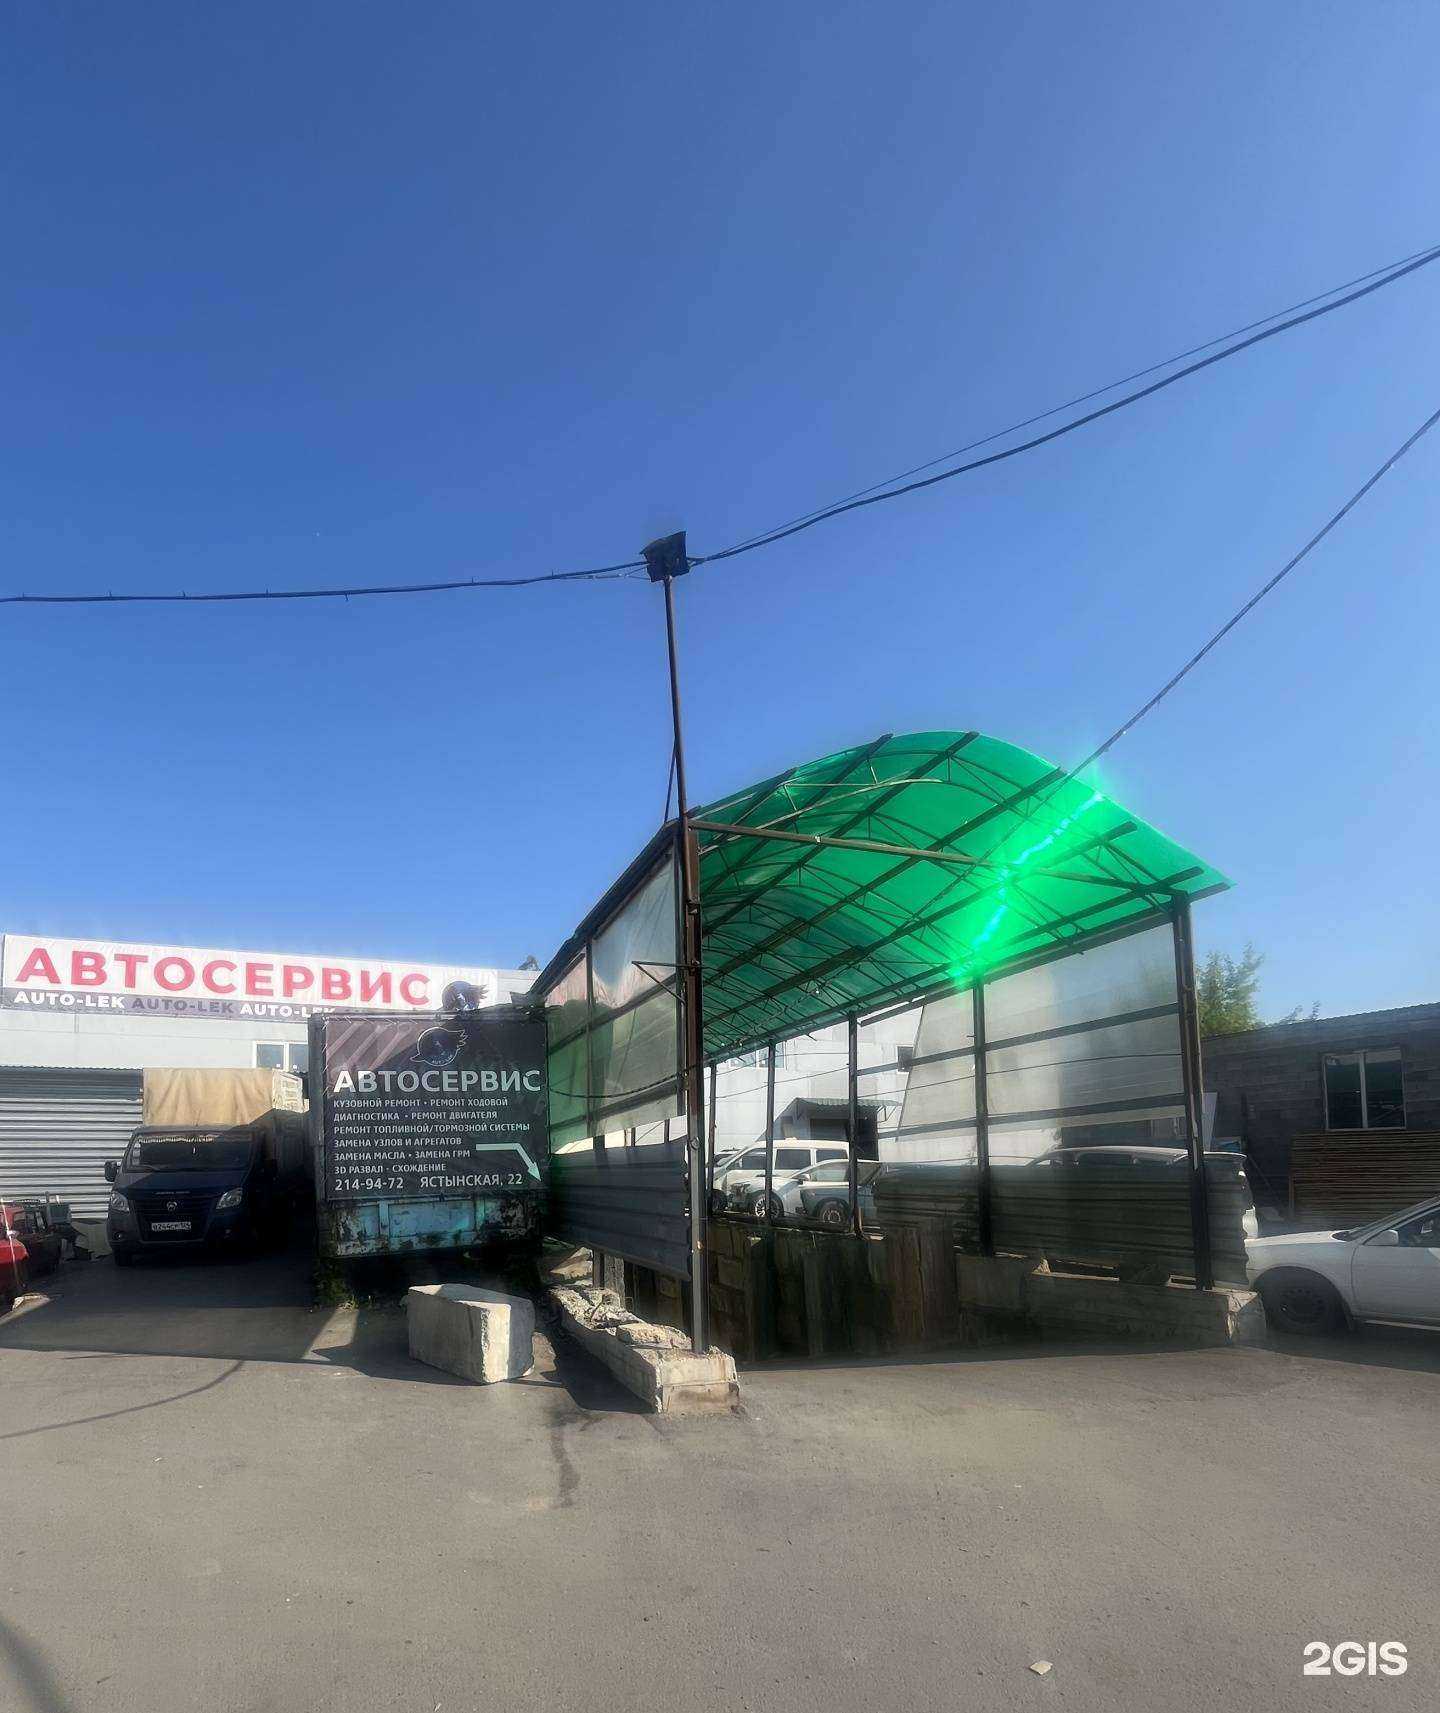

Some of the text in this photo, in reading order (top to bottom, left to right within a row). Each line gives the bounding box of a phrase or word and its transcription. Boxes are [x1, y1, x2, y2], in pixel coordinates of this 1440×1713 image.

[15, 947, 431, 1006] АВТОСЕРВИС
[13, 991, 125, 1009] AUTO-LEK
[131, 998, 234, 1014] AUTO-LEK
[333, 1070, 541, 1093] АВТОСЕРВИС
[333, 1096, 508, 1108] КУЗОВНОЙ РЕМОНТ РЕМОНТ ХОДОВОЙ
[333, 1111, 498, 1122] ДИАГНОСТИКА РЕМОНТ ДВИГАТЕЛЯ
[334, 1122, 530, 1134] РЕМОНТ ТОПЛИВНОЙ/ТОРМОЗНОЙ СИСТЕМЫ
[334, 1137, 462, 1148] ЗАМЕНА УЗЛОВ И АГРЕГАТОВ
[334, 1149, 470, 1161] ЗАМЕНА МАСЛА ЗАМЕНА ГРМ
[349, 1165, 383, 1174] РАЗВАЛ
[392, 1163, 447, 1173] СХОЖДЕНИЕ
[334, 1173, 523, 1191] 214-94-72 ЯСТЫНСКАЯ, 22
